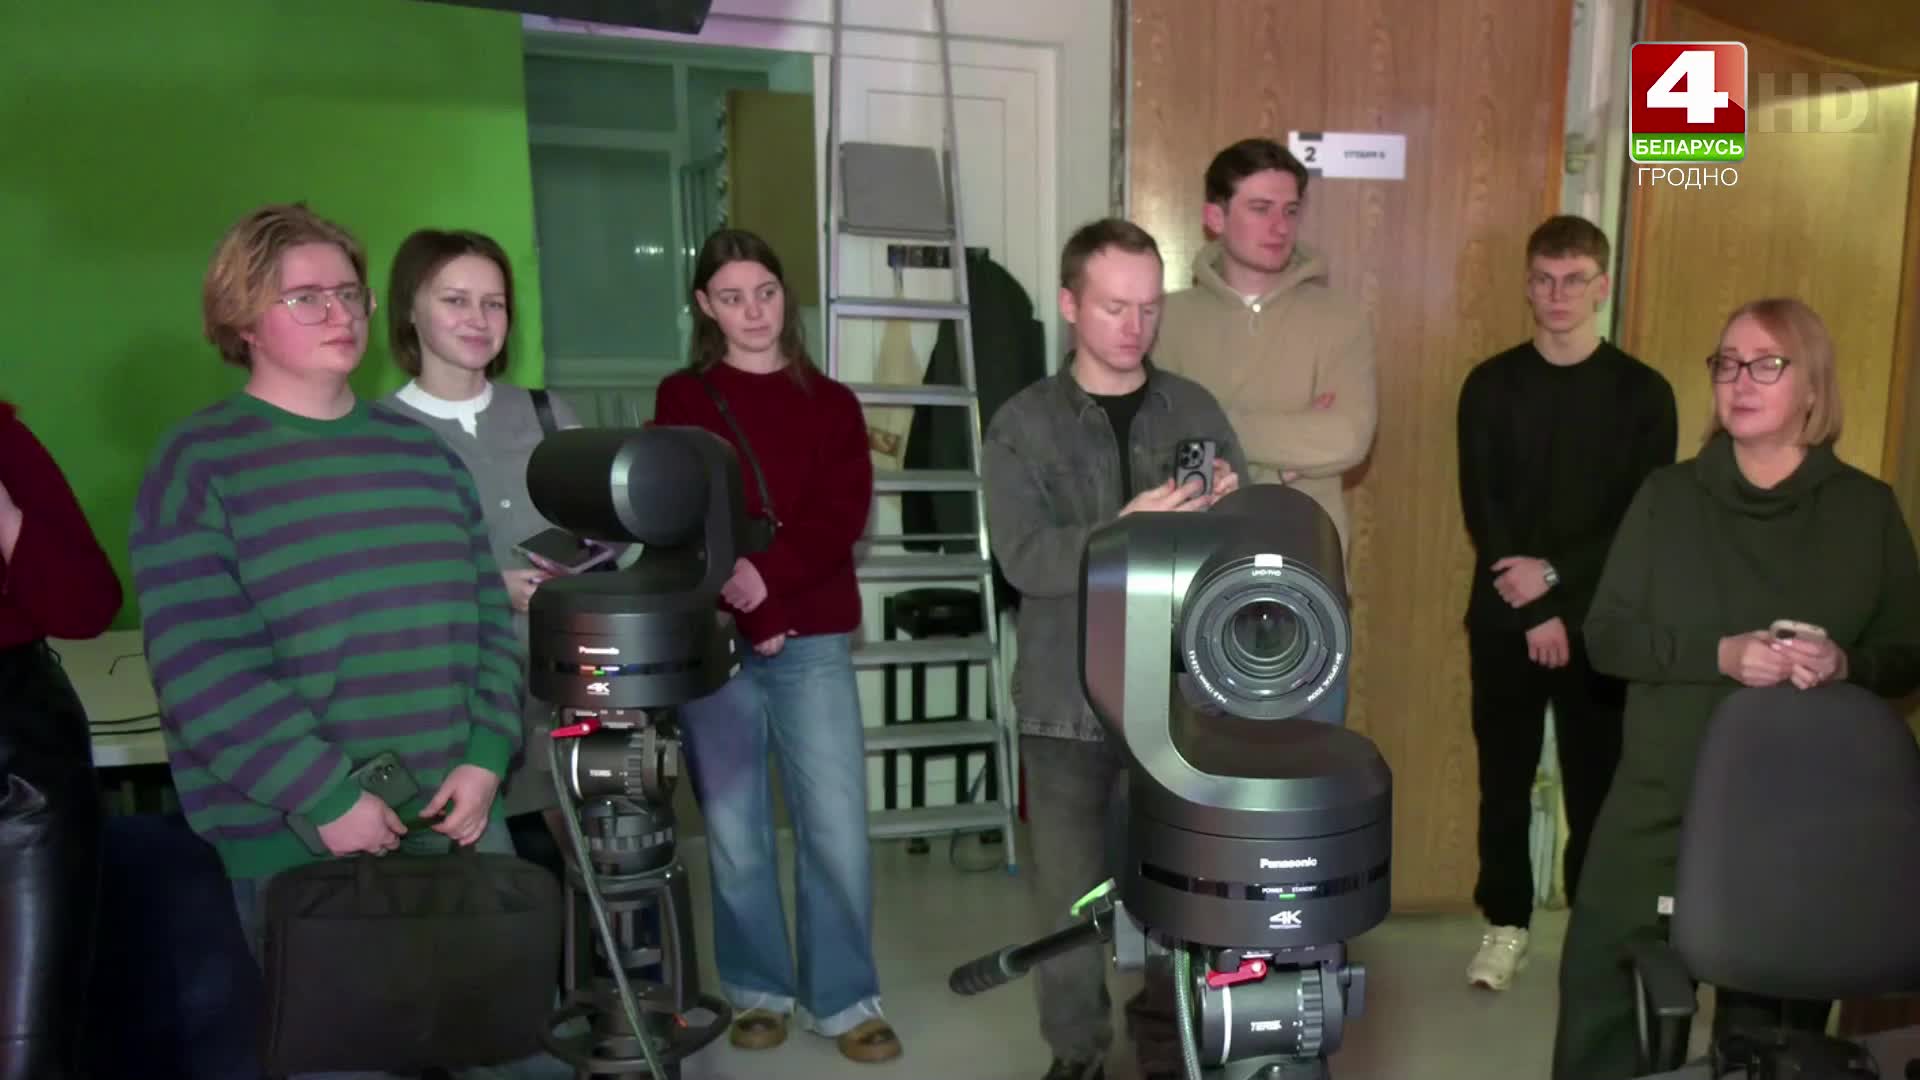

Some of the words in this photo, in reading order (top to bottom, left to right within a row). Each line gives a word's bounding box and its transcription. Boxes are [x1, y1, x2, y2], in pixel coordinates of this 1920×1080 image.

[1304, 146, 1316, 162] 2
[1259, 857, 1318, 868] Panasonic
[1269, 910, 1302, 925] 4K
